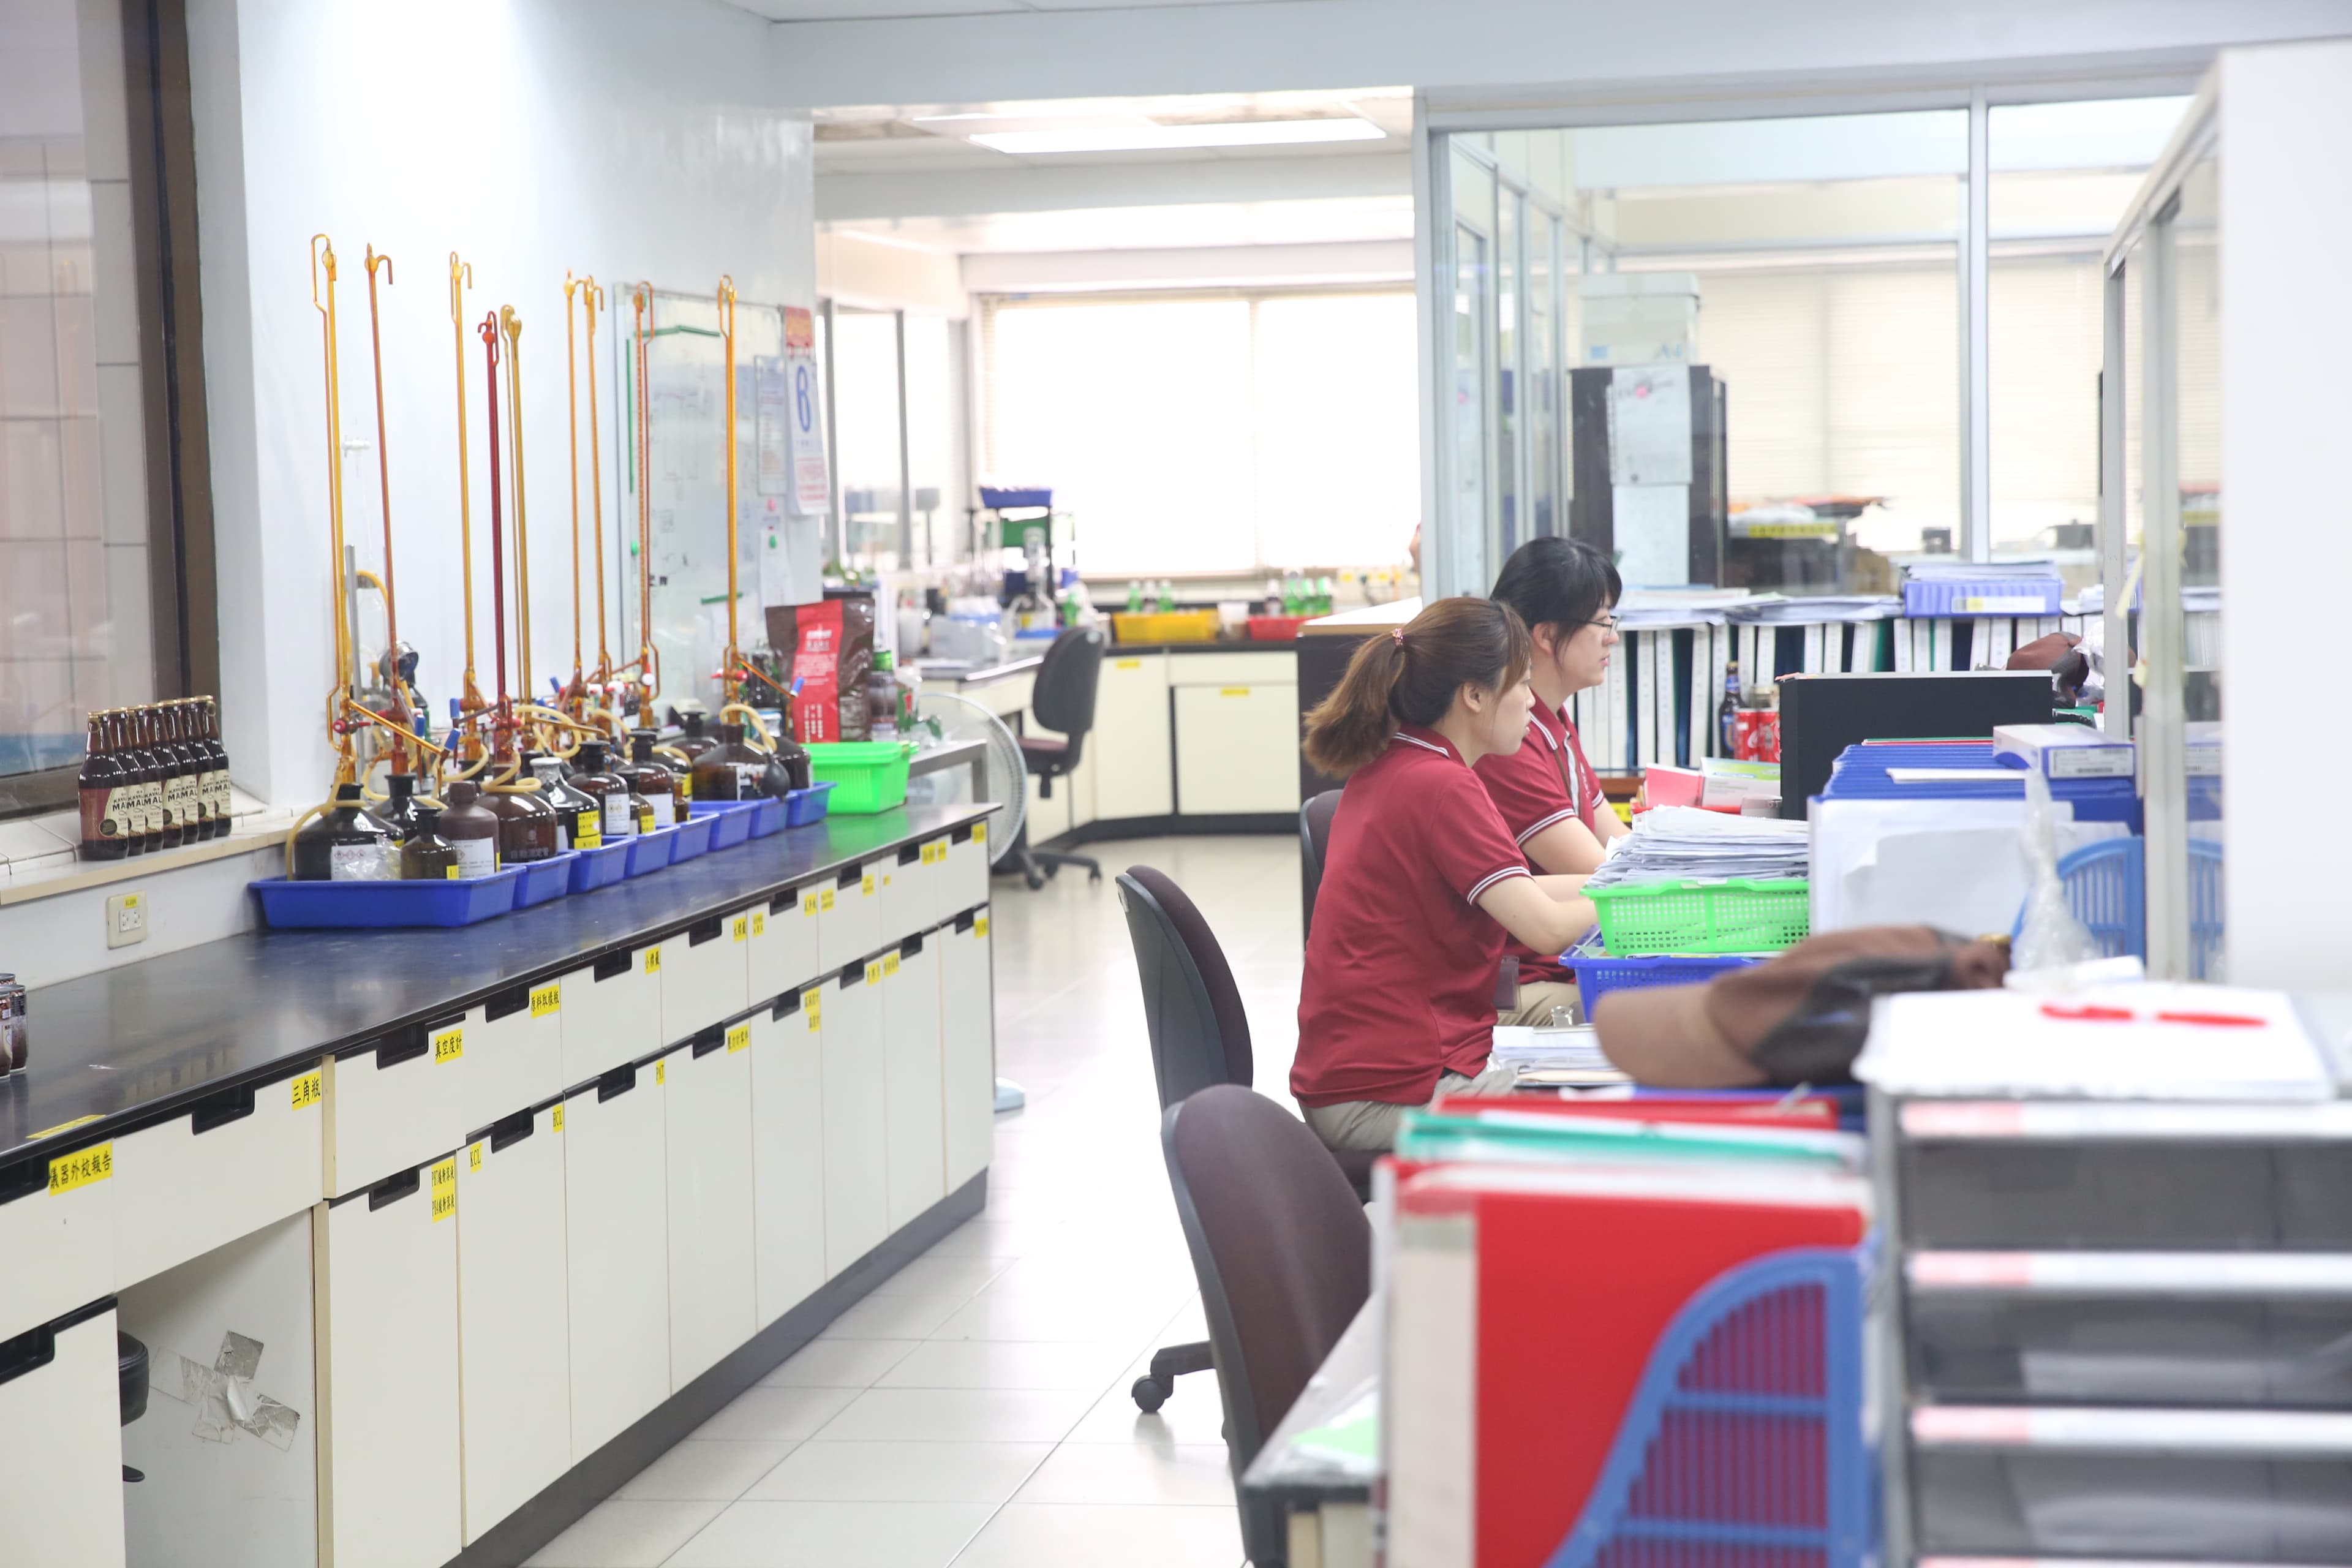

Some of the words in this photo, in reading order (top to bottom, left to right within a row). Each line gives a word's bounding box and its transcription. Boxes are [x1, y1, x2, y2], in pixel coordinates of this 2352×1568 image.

[435, 1033, 462, 1060] 真空度計
[292, 1077, 320, 1104] 三角瓶
[50, 1150, 111, 1189] 儀器外校報告
[470, 1148, 481, 1167] KCL
